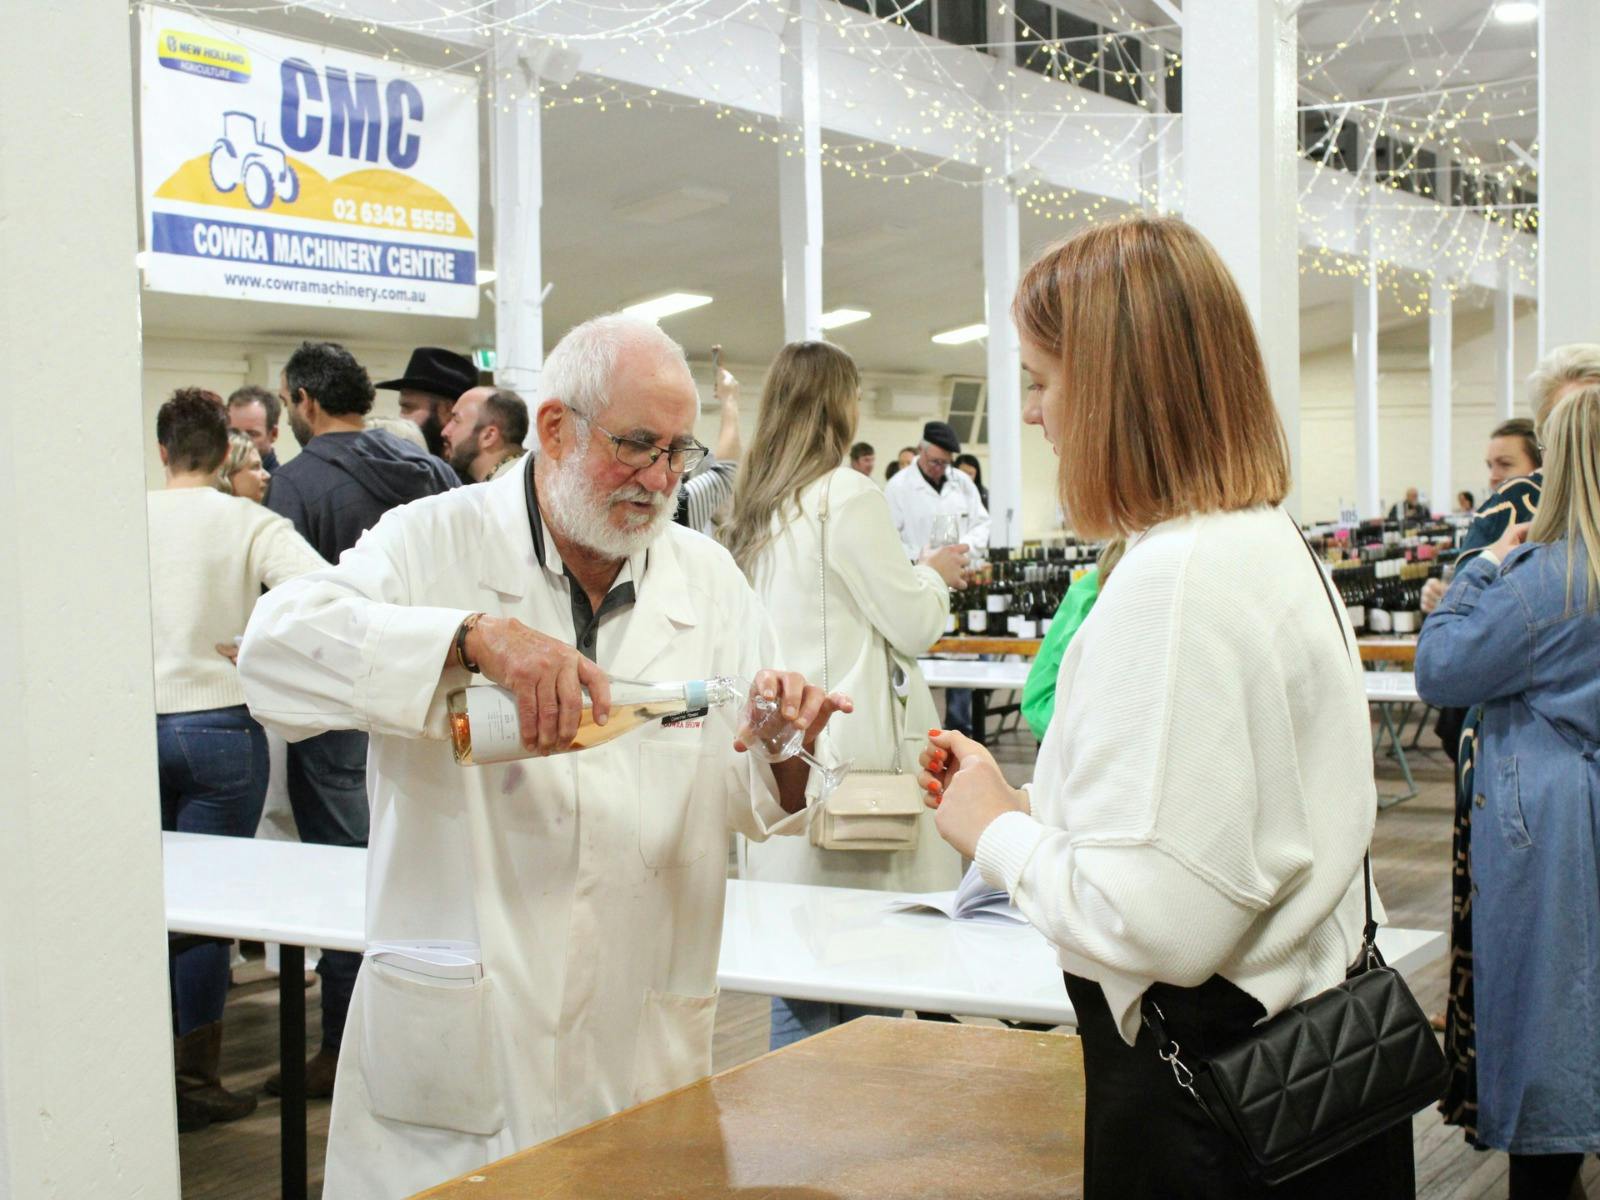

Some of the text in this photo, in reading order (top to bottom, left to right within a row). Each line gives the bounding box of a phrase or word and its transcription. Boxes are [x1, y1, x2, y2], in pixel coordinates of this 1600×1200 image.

[179, 43, 245, 64] NEW HOLLAND
[280, 57, 424, 169] CMC
[333, 199, 455, 233] 02 6342 5555
[193, 222, 455, 280] COWRA MACHINERY CENTRE
[224, 272, 426, 303] www.cowramachinery.com.au
